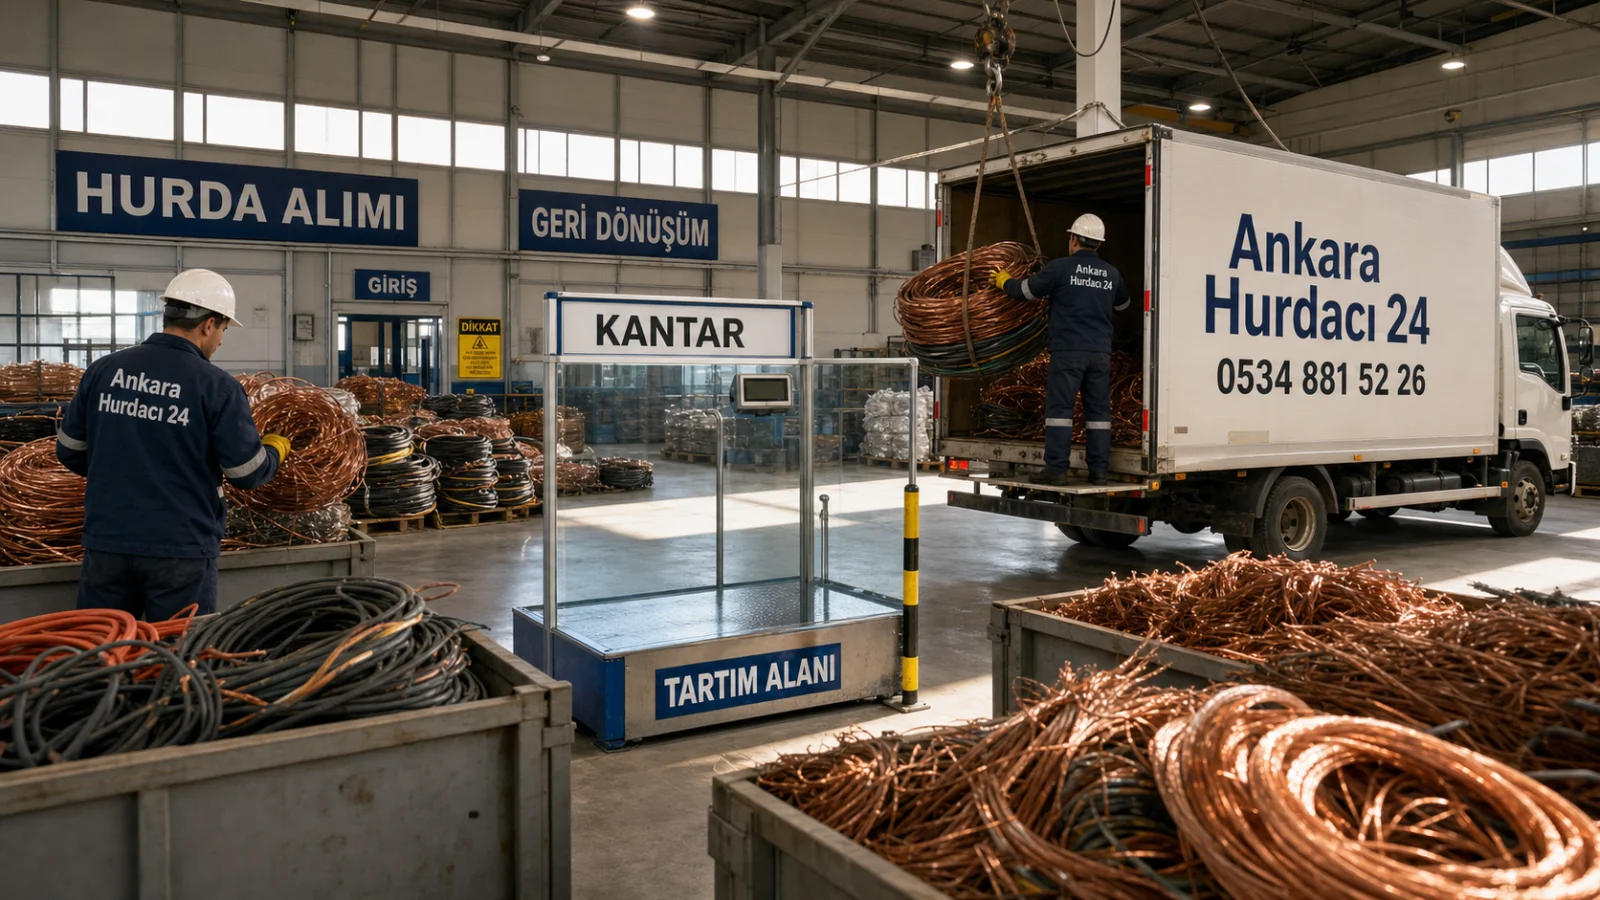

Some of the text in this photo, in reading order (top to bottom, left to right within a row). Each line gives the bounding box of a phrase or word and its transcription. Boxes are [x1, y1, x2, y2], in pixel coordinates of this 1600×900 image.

[76, 171, 405, 231] HURDA ALIMI
[531, 203, 709, 253] GERİ DÖNÜŞÜM
[1228, 212, 1381, 284] Ankara
[367, 274, 418, 299] GİRİŞ
[1070, 275, 1113, 291] Hurdacı 24
[1075, 263, 1108, 278] Ankara
[461, 319, 499, 332] DİKKAT
[1205, 274, 1430, 345] Hurdacı 24
[596, 313, 745, 349] KANTAR
[109, 367, 182, 399] Ankara
[1216, 357, 1426, 396] 0534 881 52 26
[98, 392, 190, 427] Hurdacı 24
[663, 653, 836, 708] TARTIM ALANI
